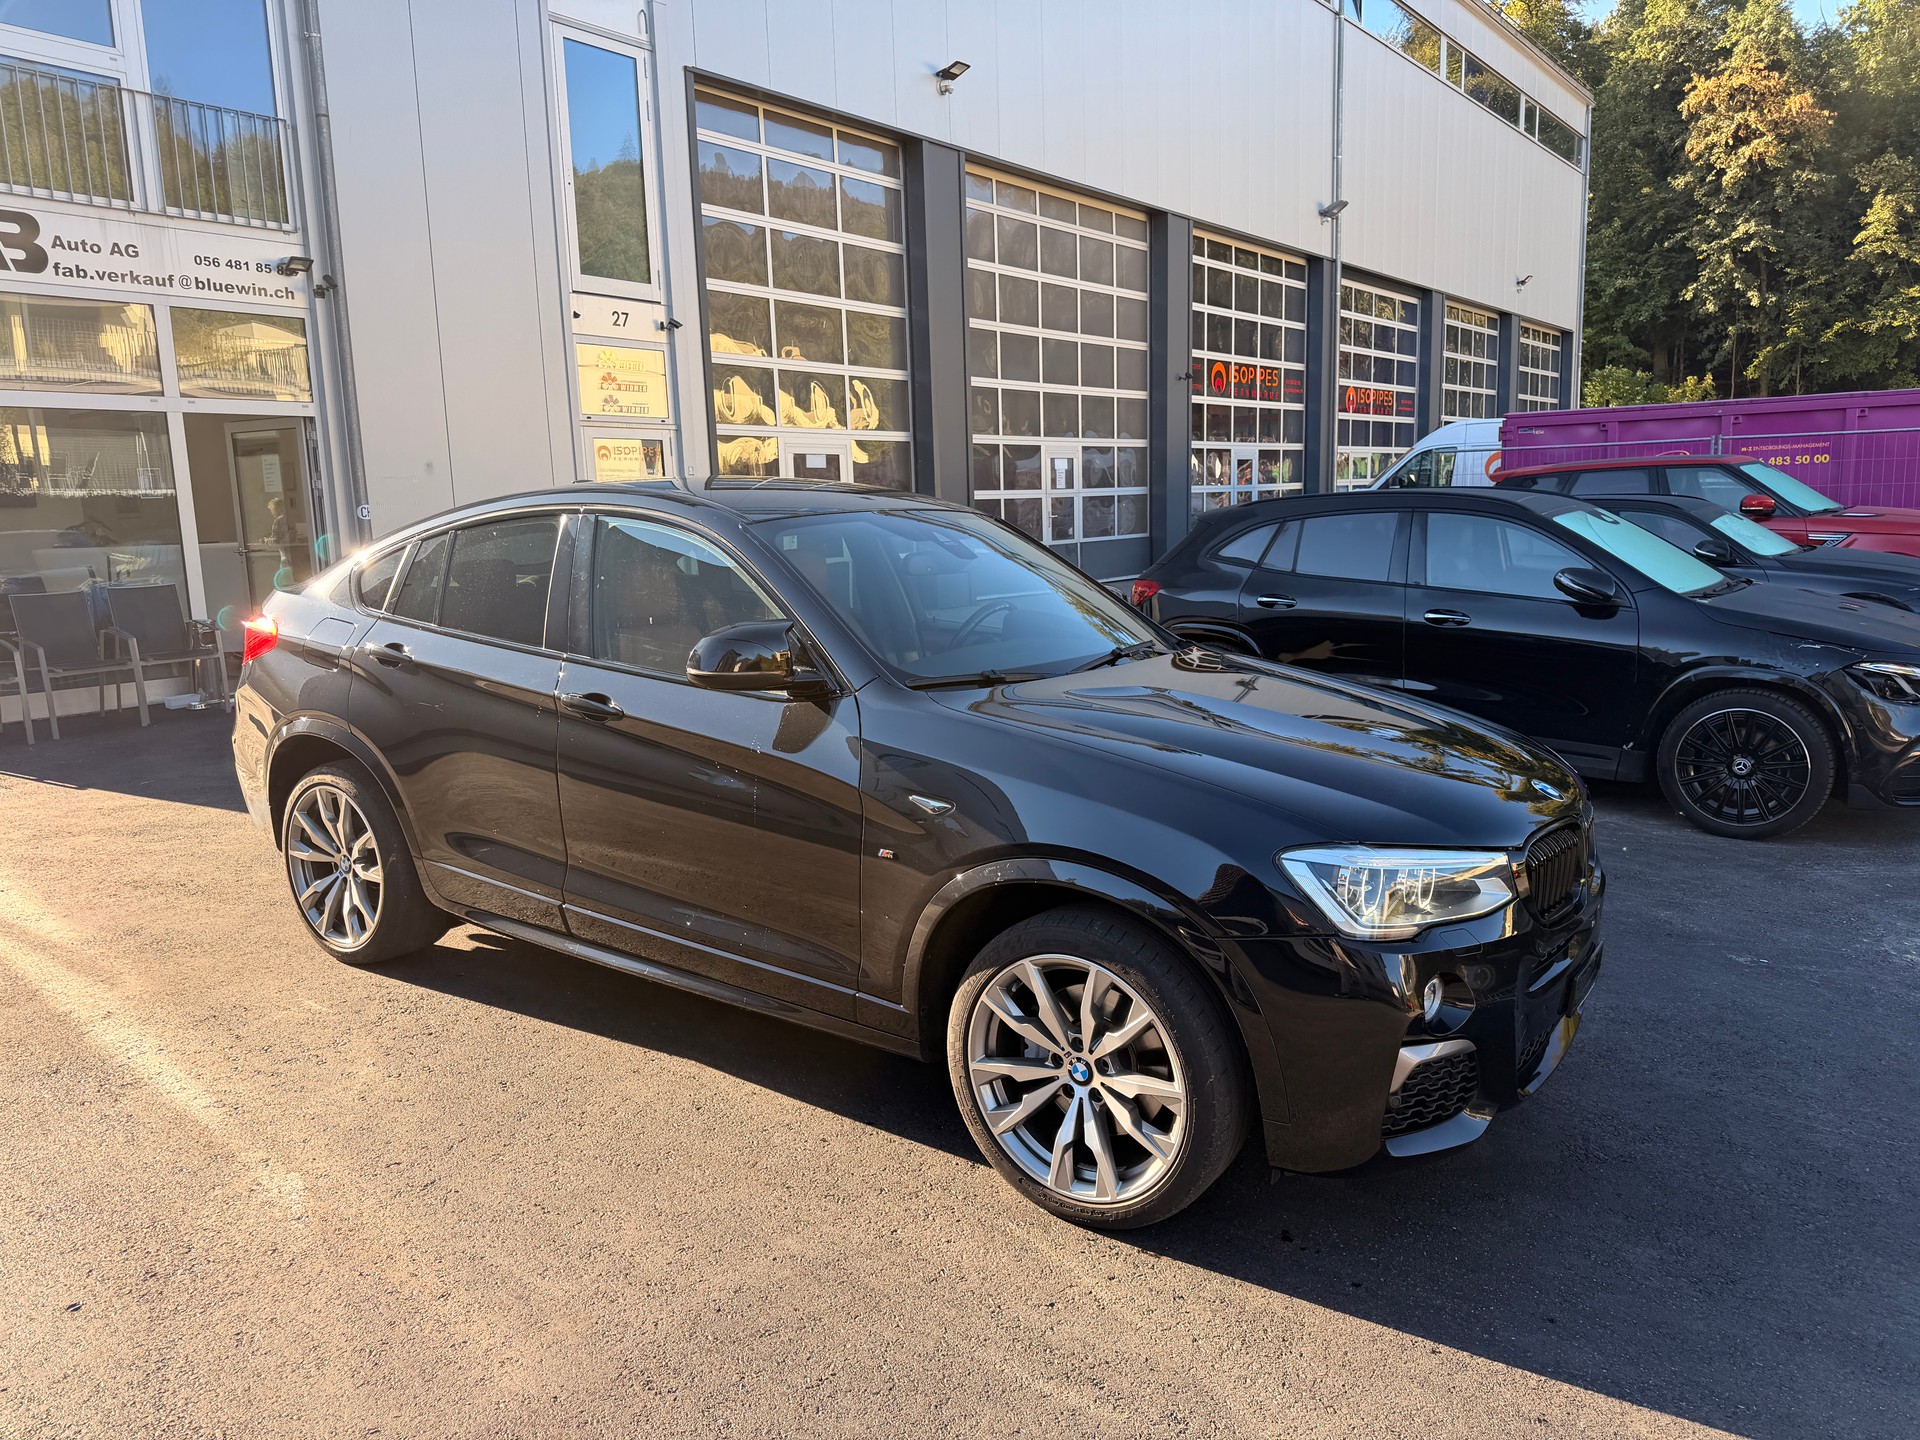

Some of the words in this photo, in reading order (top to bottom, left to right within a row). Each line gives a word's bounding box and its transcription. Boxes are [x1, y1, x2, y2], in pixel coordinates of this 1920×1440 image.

[51, 235, 102, 254] Auto
[109, 242, 140, 258] AG
[194, 255, 221, 268] 056
[225, 259, 250, 271] 481
[256, 262, 272, 274] 85
[612, 310, 629, 327] 27
[1228, 364, 1279, 387] ISOPIPES
[1357, 388, 1393, 406] ISOPIPES
[1768, 456, 1791, 466] 483
[1794, 455, 1810, 465] 50
[1813, 454, 1830, 464] 00
